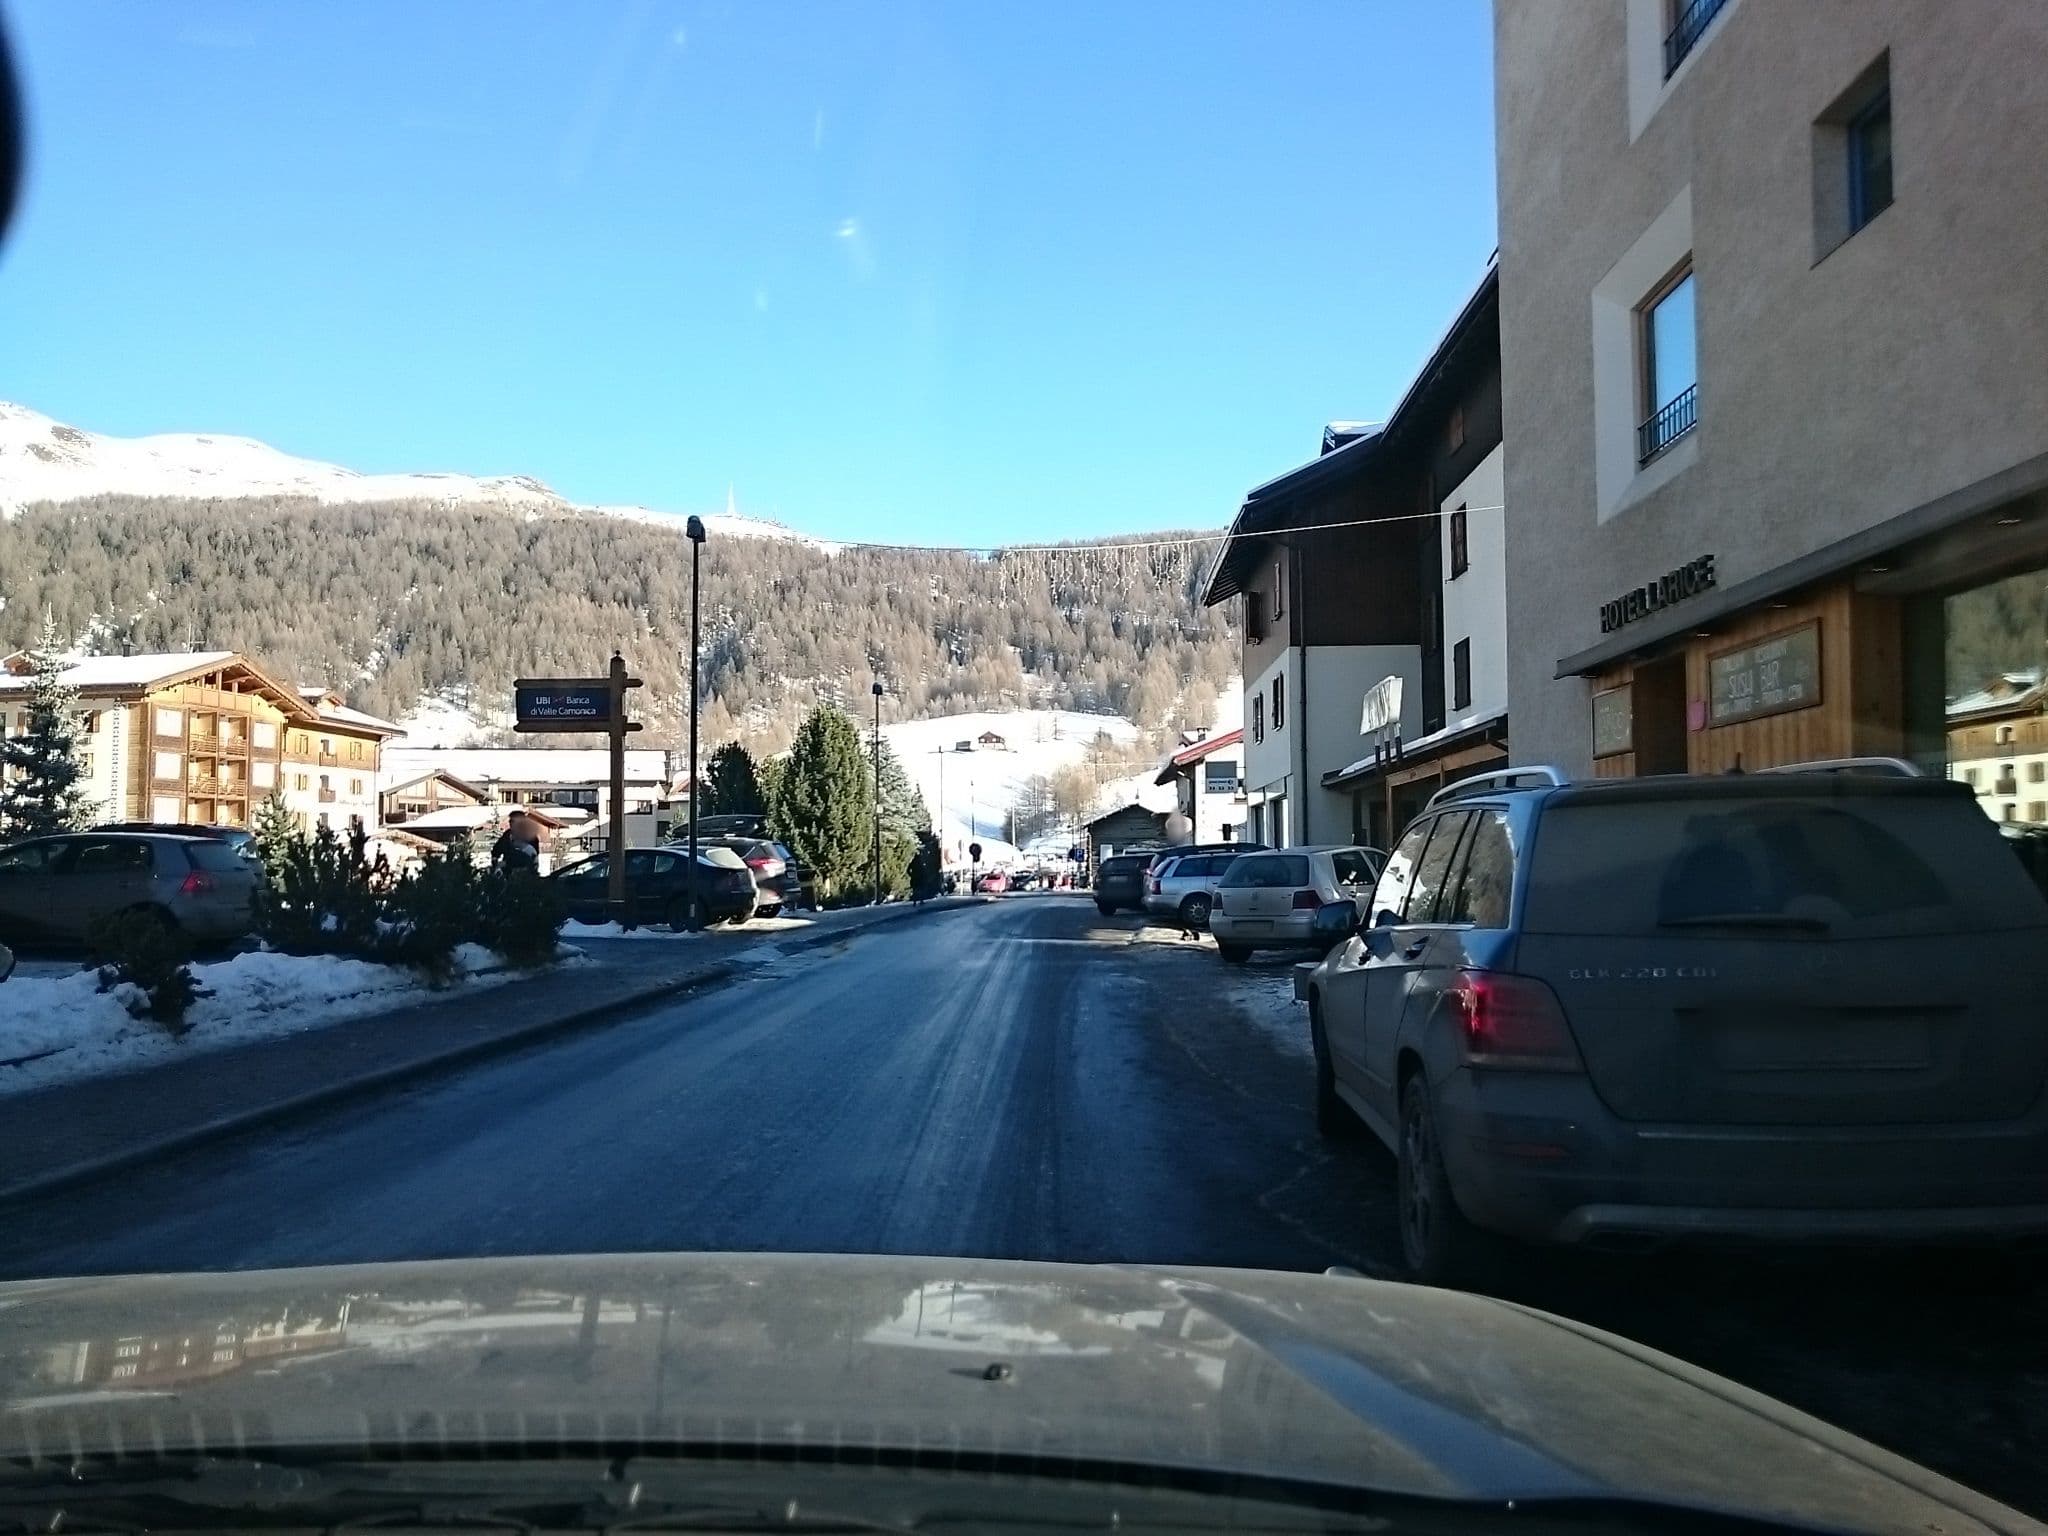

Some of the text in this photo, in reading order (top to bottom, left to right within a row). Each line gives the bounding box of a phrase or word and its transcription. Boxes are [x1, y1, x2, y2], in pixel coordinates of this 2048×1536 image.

[1600, 555, 1716, 633] HOTEL LARICE
[535, 696, 590, 705] UBI Banca
[530, 707, 597, 715] di Valle Camonica
[1568, 967, 1717, 979] GLK 220 CDI
